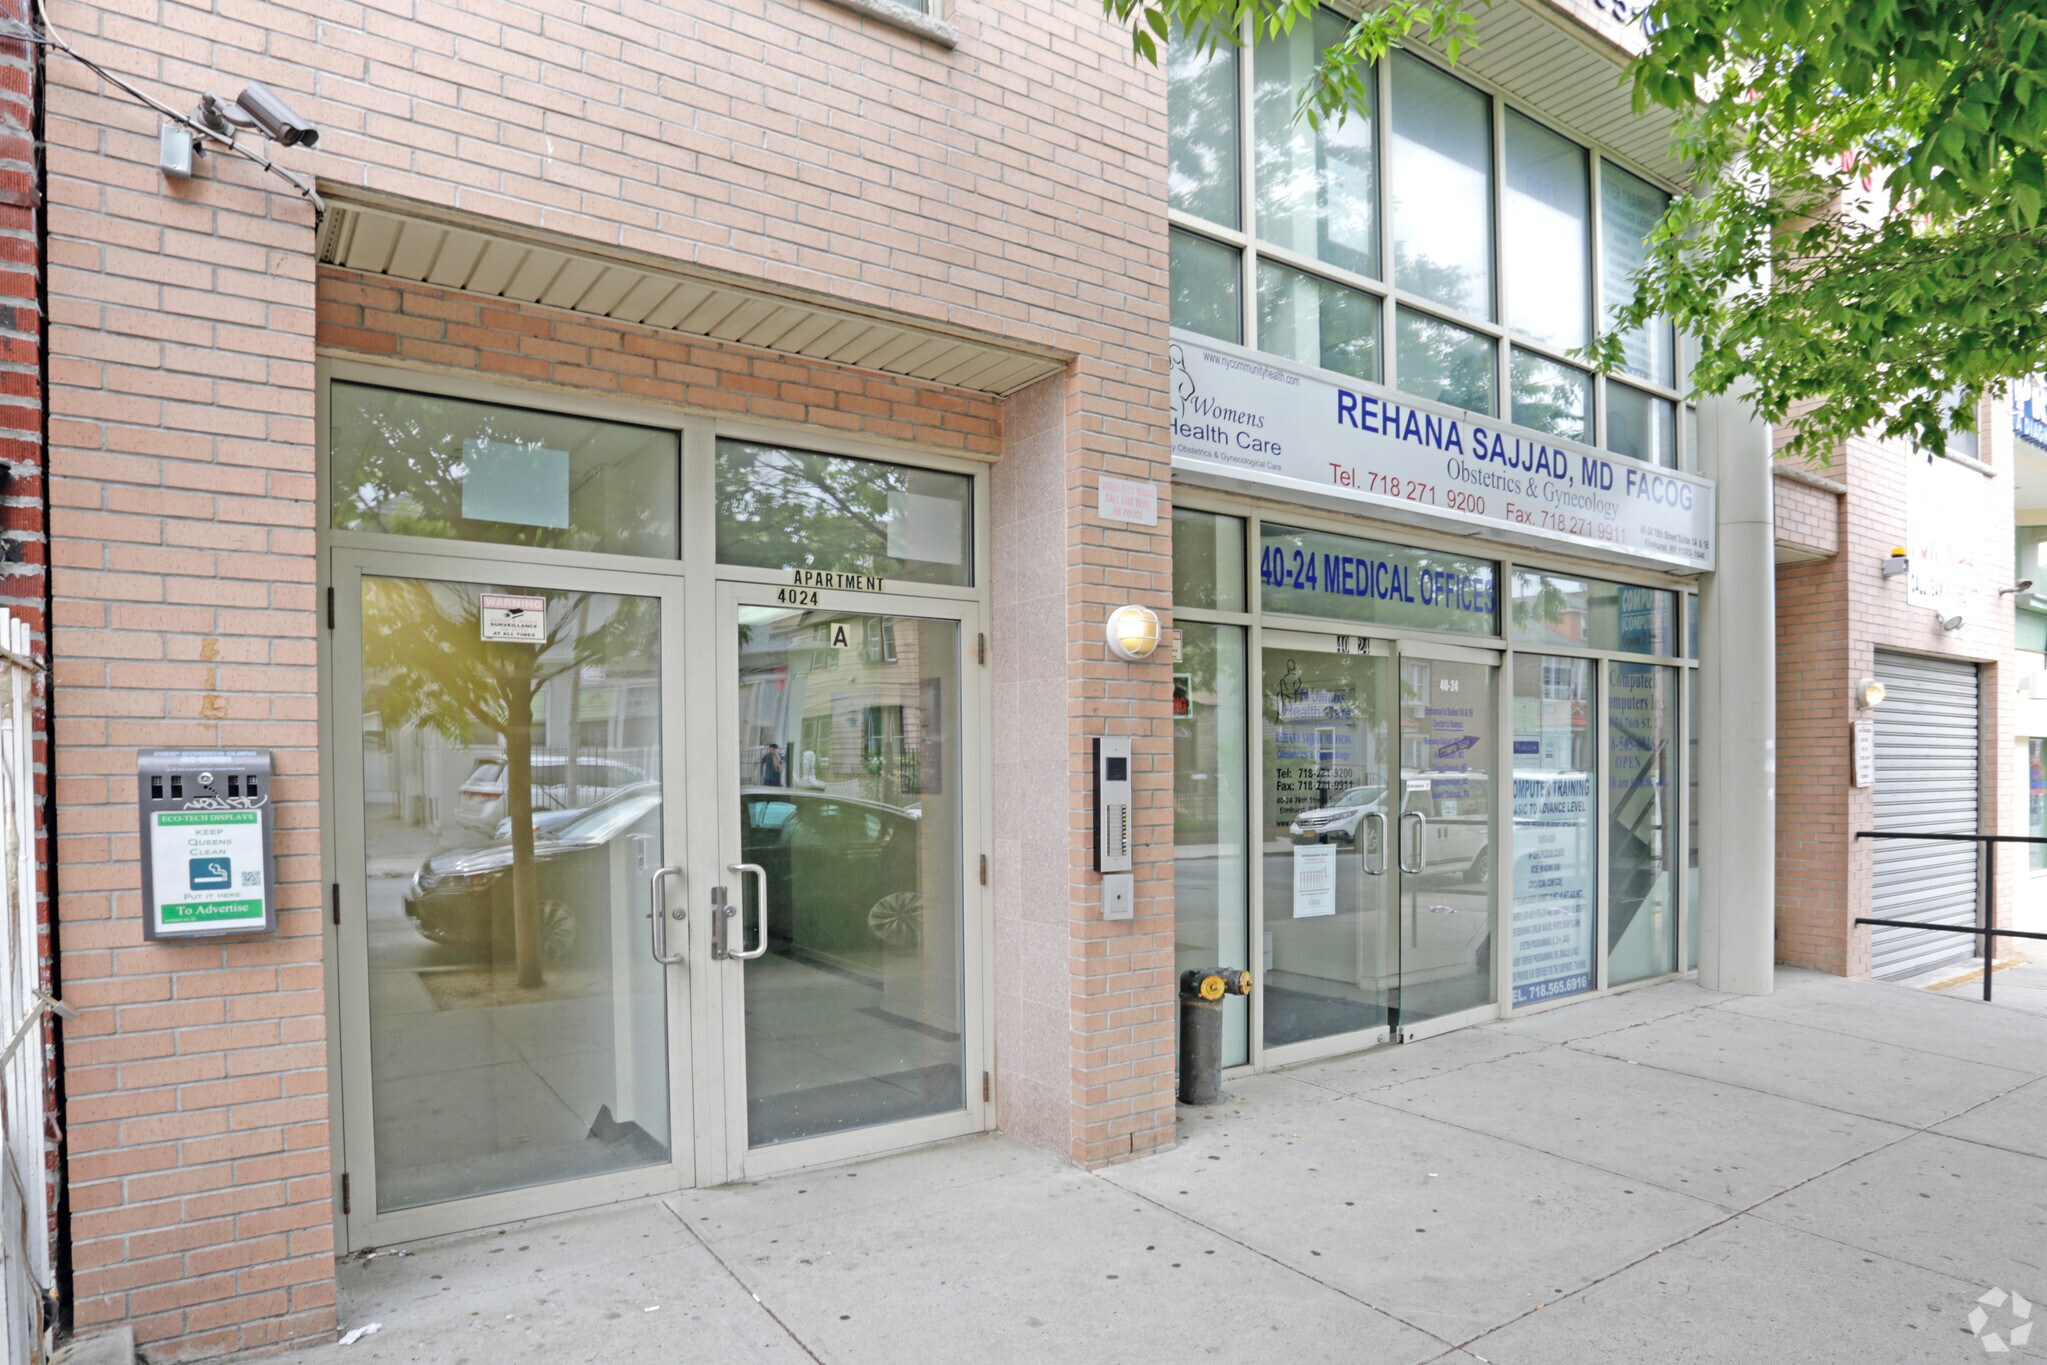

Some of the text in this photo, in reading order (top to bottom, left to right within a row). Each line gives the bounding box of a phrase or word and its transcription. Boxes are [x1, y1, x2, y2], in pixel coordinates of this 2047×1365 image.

[1203, 351, 1300, 387] www.nycommunityhealth.com
[1190, 396, 1265, 429] Womens
[1236, 430, 1282, 456] Care
[1338, 389, 1693, 511] REHANA SAJJAD, MD FACOG
[1177, 444, 1212, 458] Obstetrics
[1221, 452, 1266, 468] Gynecological
[1267, 461, 1282, 472] Care
[1447, 457, 1620, 521] Obstetrics & Gynecology
[1329, 463, 1626, 544] Tel. 718 271 9200 Fax. 718 271 9911
[794, 570, 884, 592] APARTMENT
[1261, 545, 1495, 614] 40-24 MEDICAL OFFICES
[487, 598, 541, 610] WARNING
[778, 588, 818, 606] 4024
[833, 626, 848, 647] A
[1337, 636, 1349, 653] 40
[1439, 679, 1459, 692] 40-24
[1323, 705, 1352, 720] Care
[1609, 694, 1648, 714] omputers
[1616, 755, 1641, 769] OPEN
[1276, 768, 1292, 779] Tel:
[1276, 780, 1295, 791] Fax:
[1513, 779, 1550, 799] OMPUTER
[1552, 778, 1590, 798] TRAINING
[161, 812, 254, 823] ECO-TECH DISPLAYS
[1514, 801, 1586, 815] ASIC TO DVANCE LEVEL
[176, 903, 249, 916] To Advertise
[1513, 975, 1588, 1003] EL. 718.565.6916
